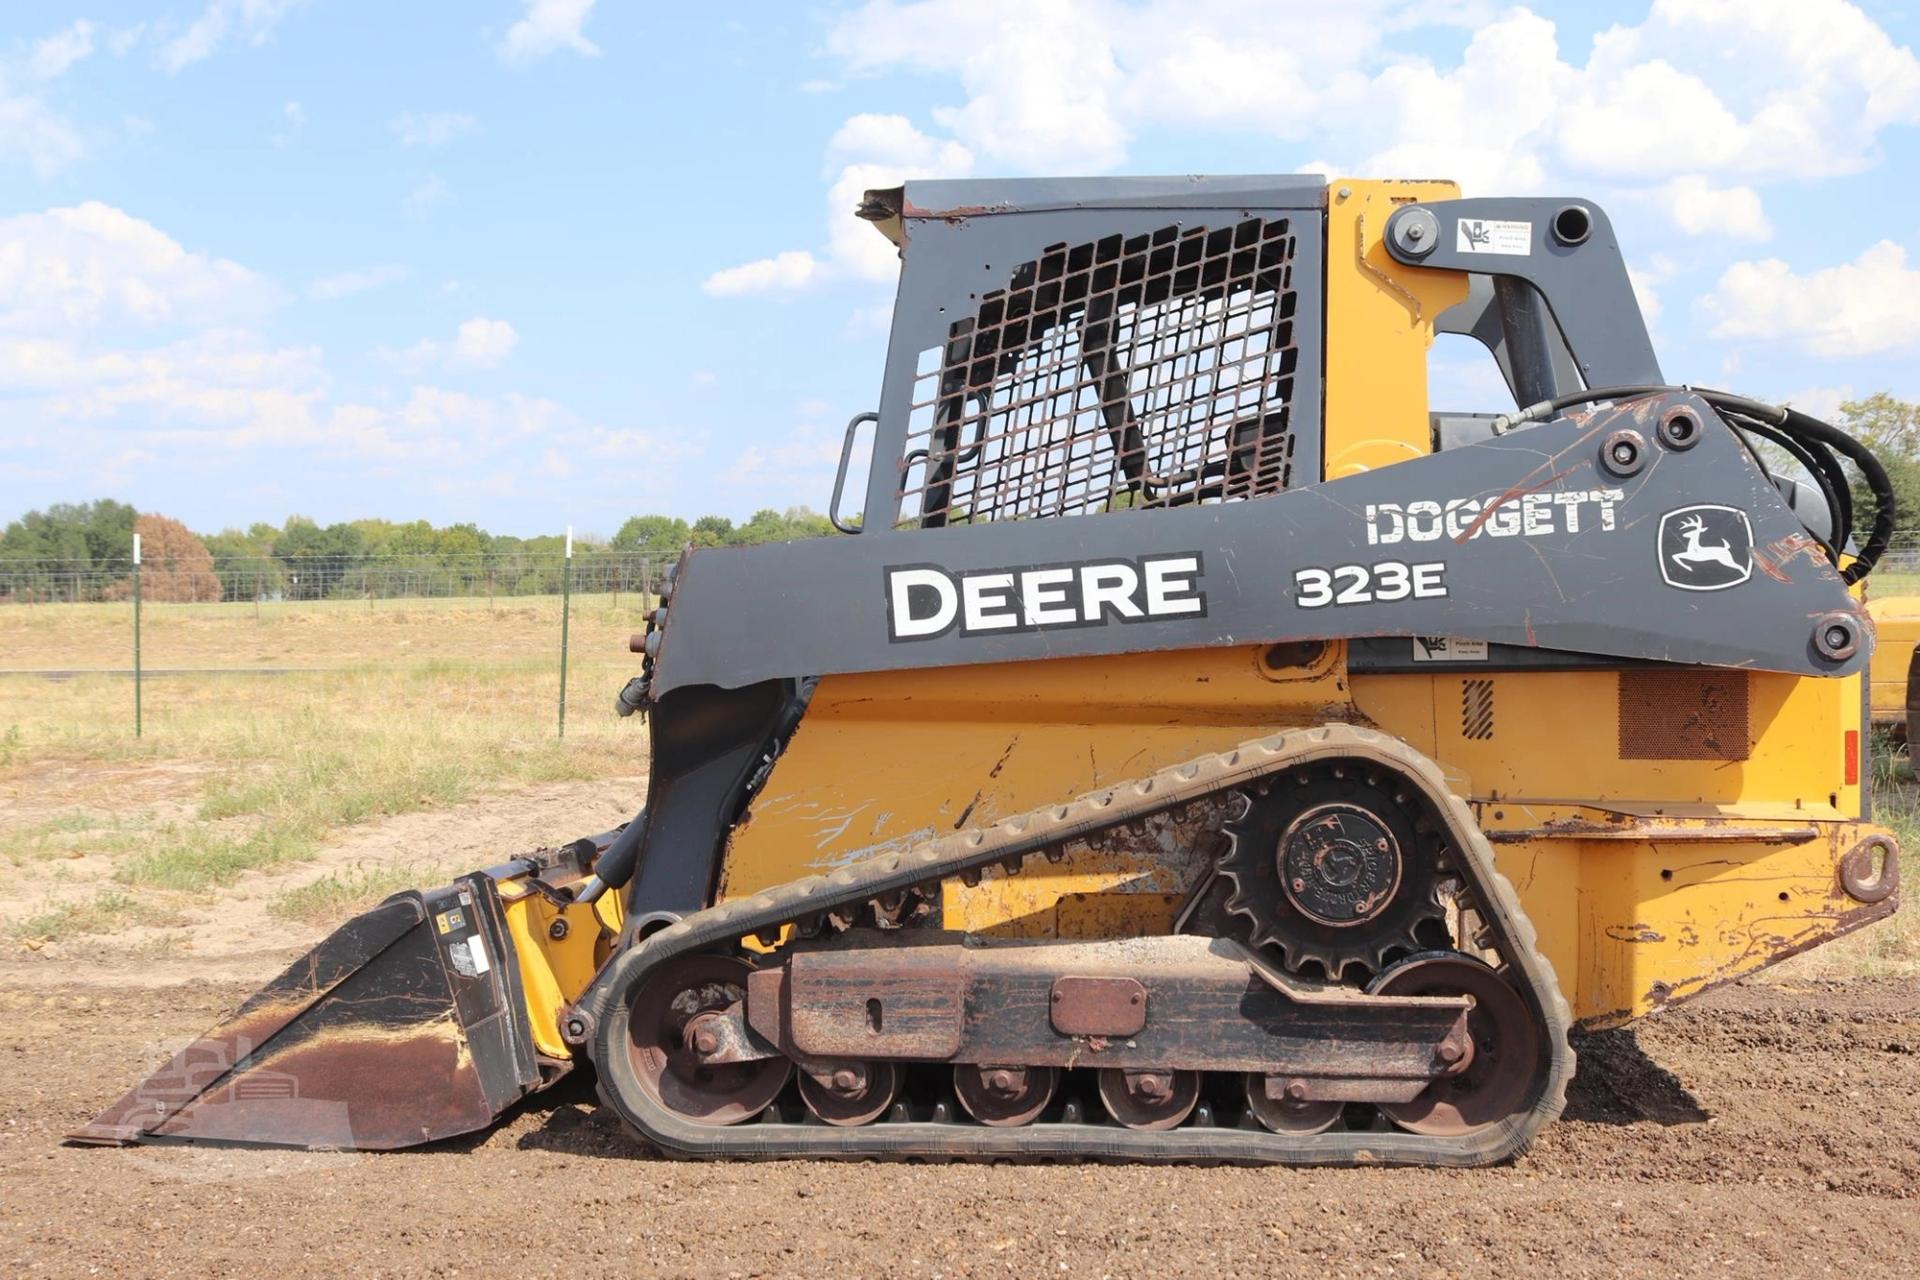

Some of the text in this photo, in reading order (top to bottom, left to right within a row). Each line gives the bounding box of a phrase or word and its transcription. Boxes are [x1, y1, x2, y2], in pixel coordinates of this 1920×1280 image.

[1365, 488, 1625, 545] DOGGETT
[889, 557, 1201, 637] DEERE
[1295, 562, 1448, 608] 323E
